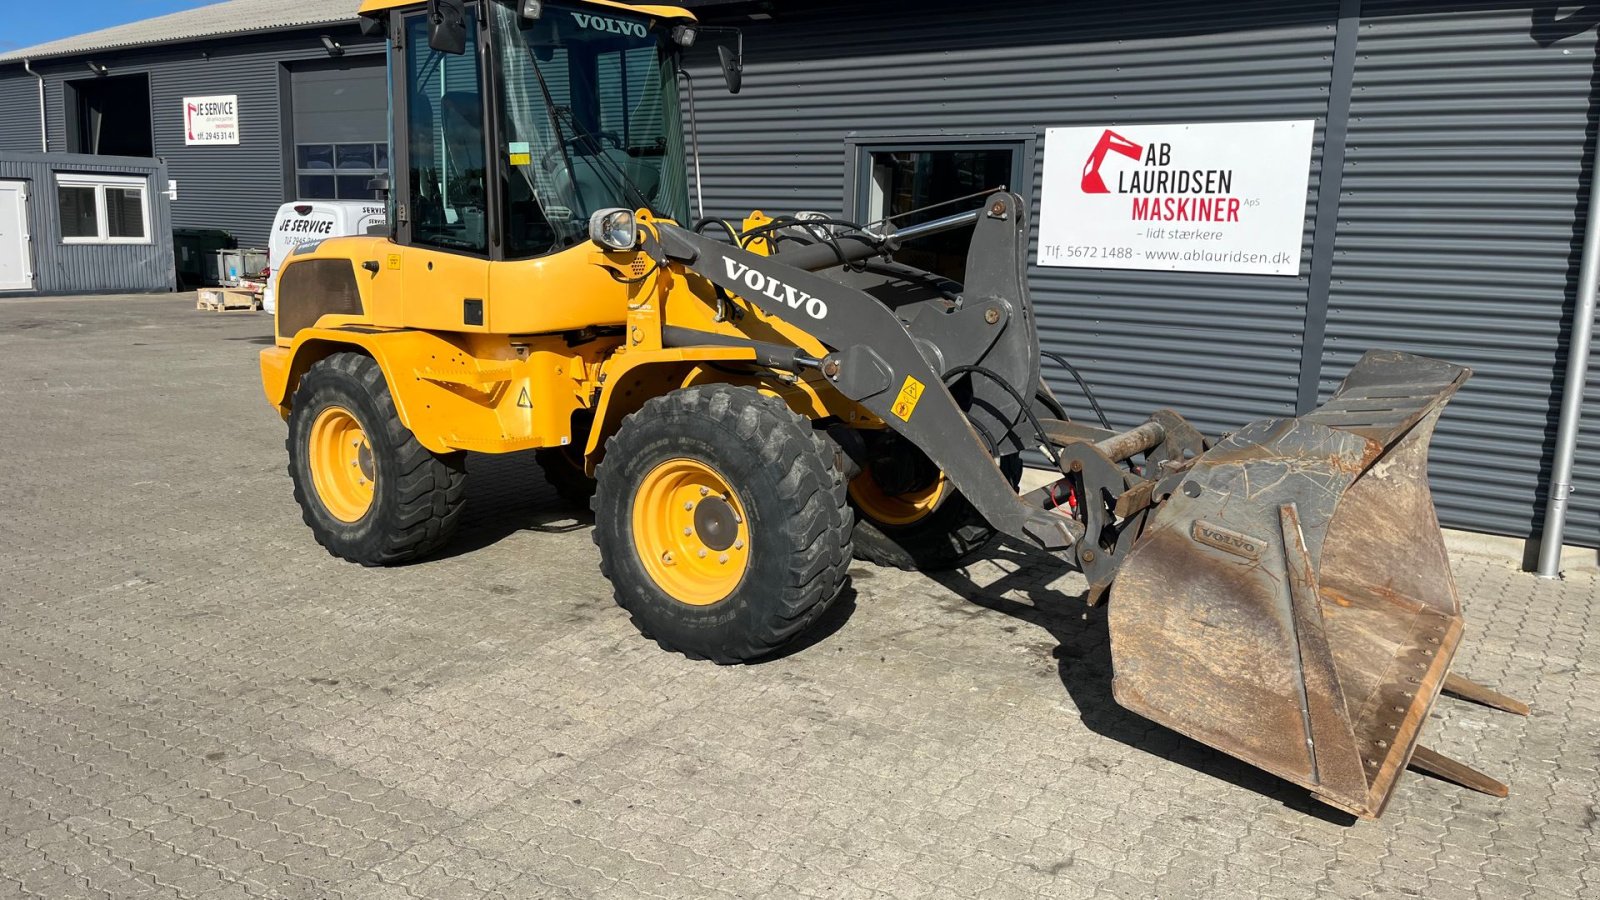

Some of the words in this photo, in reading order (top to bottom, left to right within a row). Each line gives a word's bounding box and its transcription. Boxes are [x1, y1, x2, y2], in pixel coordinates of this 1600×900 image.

[570, 12, 647, 38] VOLVO
[196, 103, 204, 116] JE
[205, 102, 233, 115] SERVICE
[206, 131, 212, 140] 29
[213, 131, 220, 140] 45
[221, 131, 227, 140] 31
[1145, 143, 1171, 166] AB
[1118, 170, 1232, 194] LAURIDSEN
[362, 206, 386, 214] SERVIC
[1131, 197, 1240, 222] MASKINER
[1243, 198, 1261, 207] ApS
[279, 219, 291, 232] JE
[291, 219, 334, 234] SERVICE
[1145, 228, 1165, 239] lidt
[1168, 229, 1223, 240] stærkere
[1045, 245, 1063, 259] Tlf.
[1067, 246, 1098, 258] 5672
[1101, 247, 1133, 259] 1488
[1145, 249, 1291, 264] www.ablauridsen.dk
[722, 255, 828, 320] VOLVO
[1202, 528, 1254, 551] VOLVO
